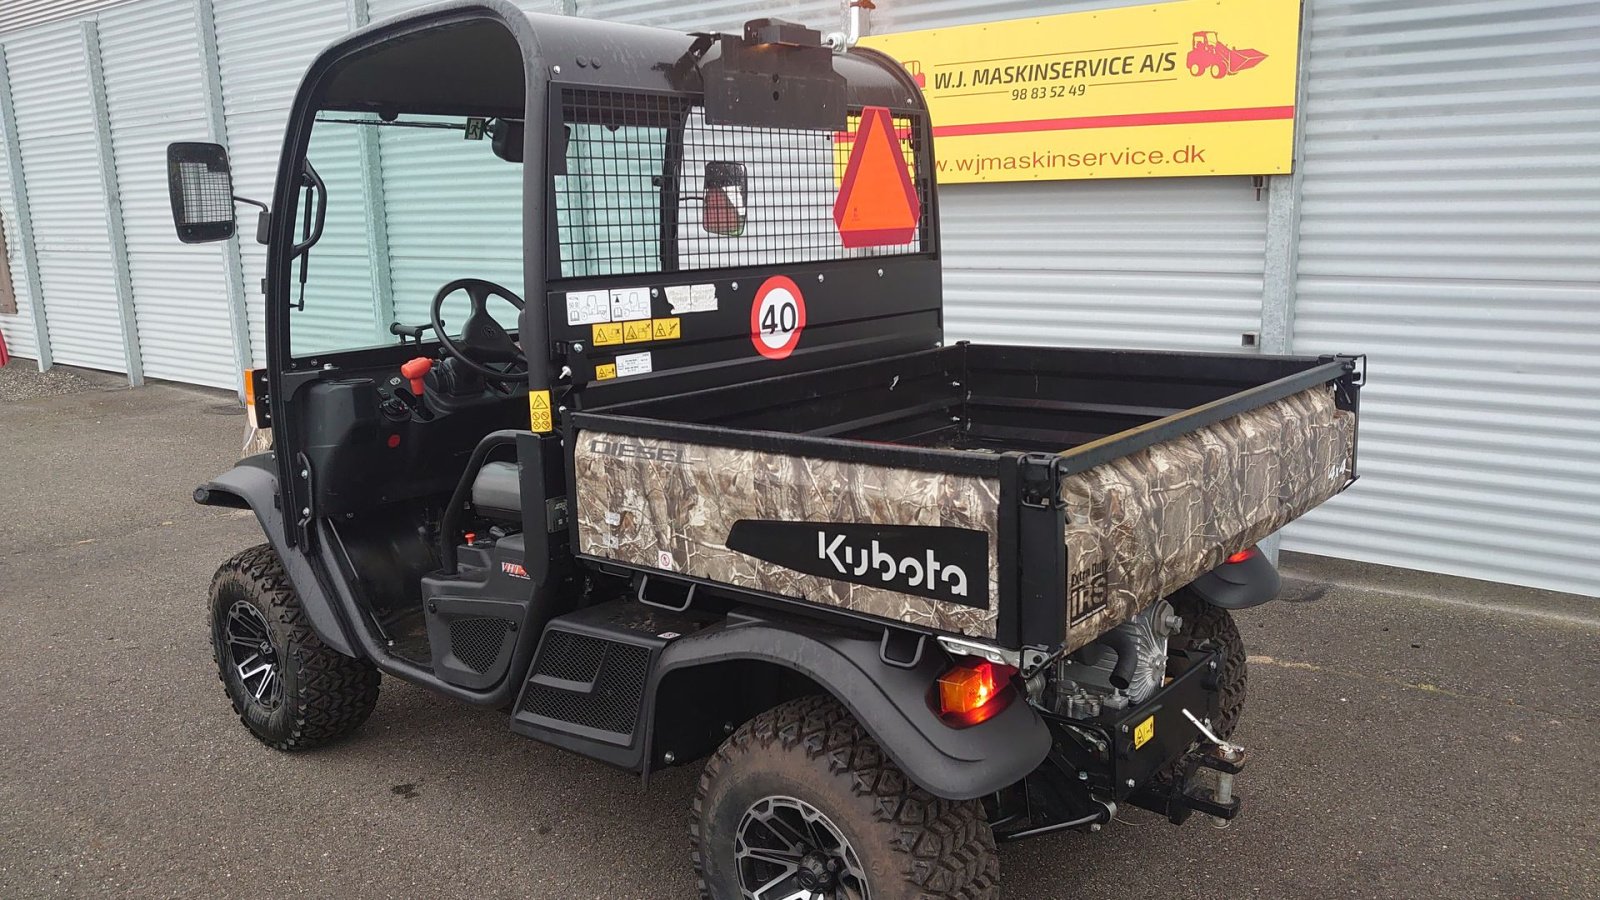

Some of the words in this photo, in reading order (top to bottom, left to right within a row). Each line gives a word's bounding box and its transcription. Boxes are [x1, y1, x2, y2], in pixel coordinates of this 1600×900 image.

[934, 71, 967, 90] W.J.
[972, 56, 1135, 87] MASKINSERVICE
[1139, 52, 1177, 74] A/S
[1011, 88, 1027, 101] 98
[1031, 87, 1047, 100] 83
[1050, 86, 1065, 98] 52
[1068, 84, 1086, 97] 49
[910, 145, 1206, 176] w.wjmaskinservice.dk
[761, 302, 797, 335] 40
[590, 440, 694, 465] DIESEL
[818, 531, 968, 597] Kubota
